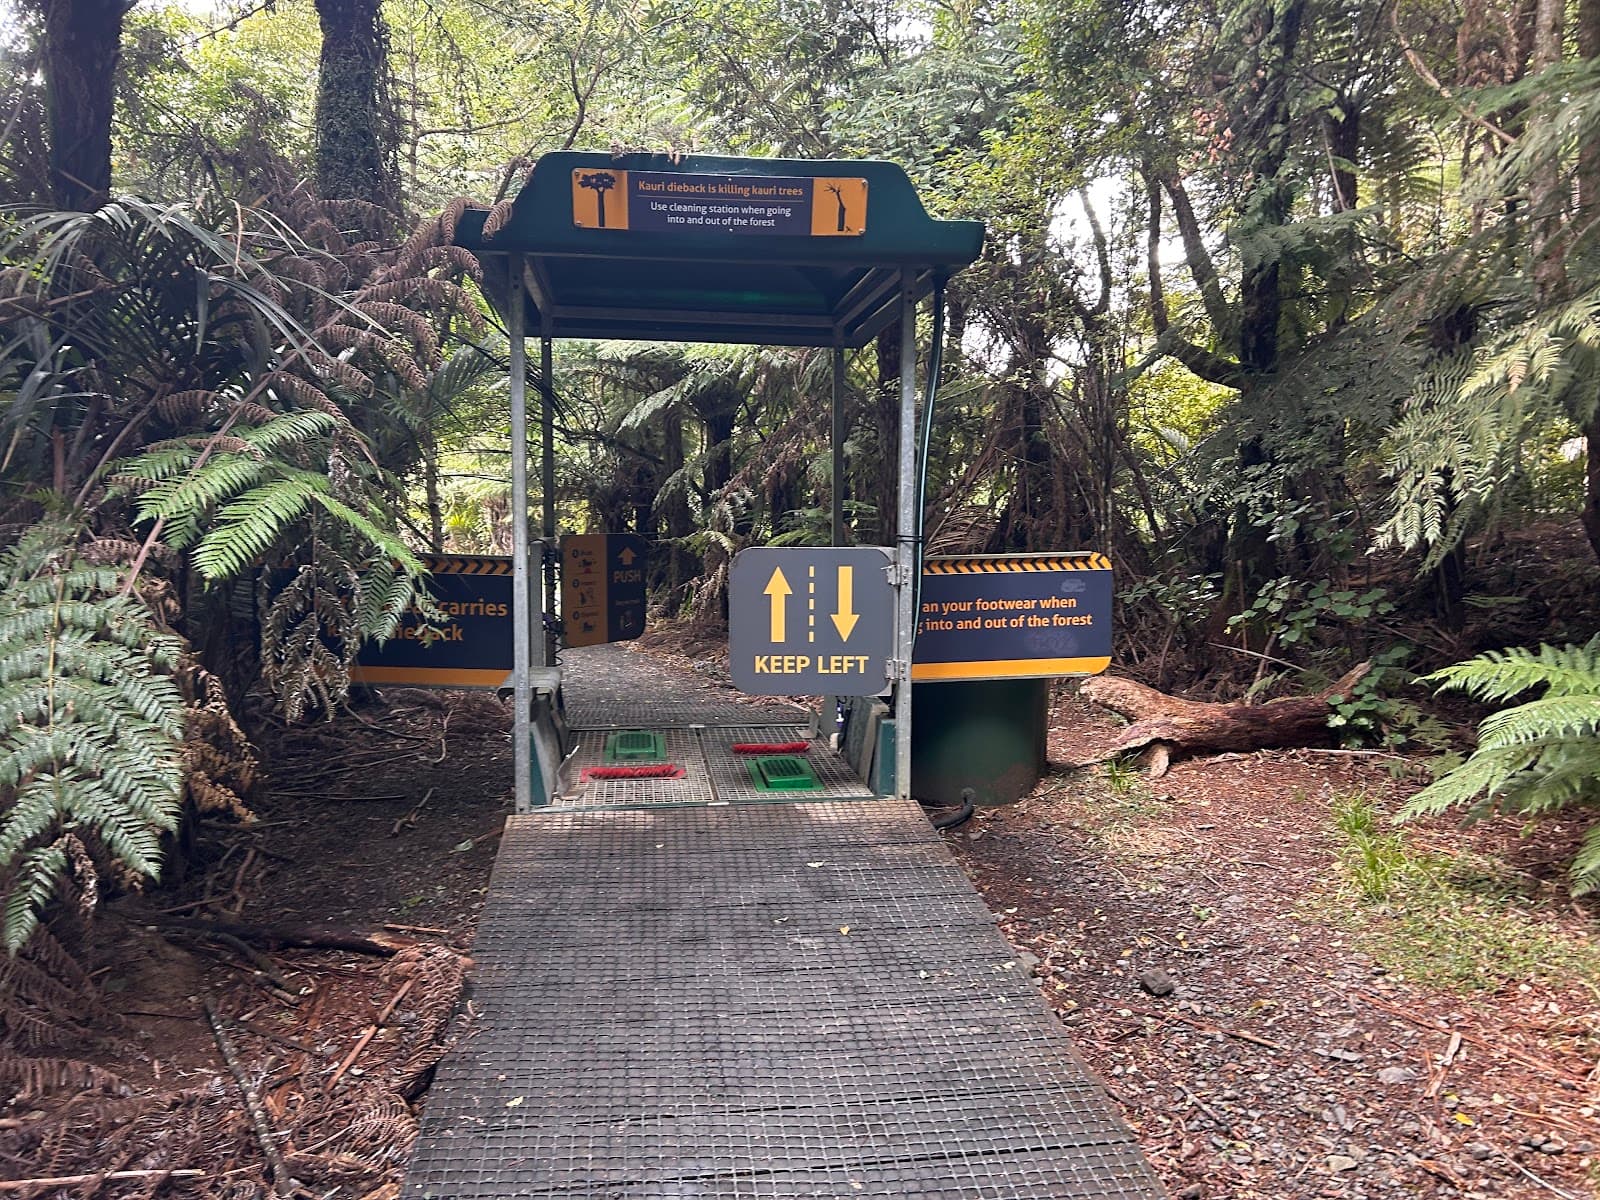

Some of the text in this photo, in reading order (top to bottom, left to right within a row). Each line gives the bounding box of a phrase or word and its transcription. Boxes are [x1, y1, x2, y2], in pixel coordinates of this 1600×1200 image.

[638, 180, 803, 197] Kauri dieback is killing kauri trees
[650, 201, 791, 217] Use cleaning station when going
[667, 215, 685, 223] into
[686, 216, 704, 224] and
[721, 217, 733, 225] of
[733, 217, 748, 225] the
[749, 217, 775, 226] forest
[613, 569, 641, 583] PUSH
[437, 597, 508, 616] carries
[942, 602, 972, 615] your
[976, 596, 1037, 611] footwear
[1039, 596, 1077, 609] when
[925, 618, 953, 630] into
[956, 617, 982, 629] and
[984, 617, 1007, 629] out
[1010, 615, 1025, 628] of
[1027, 615, 1050, 627] the
[1053, 614, 1093, 626] forest
[754, 655, 869, 674] KEEP LEFT
